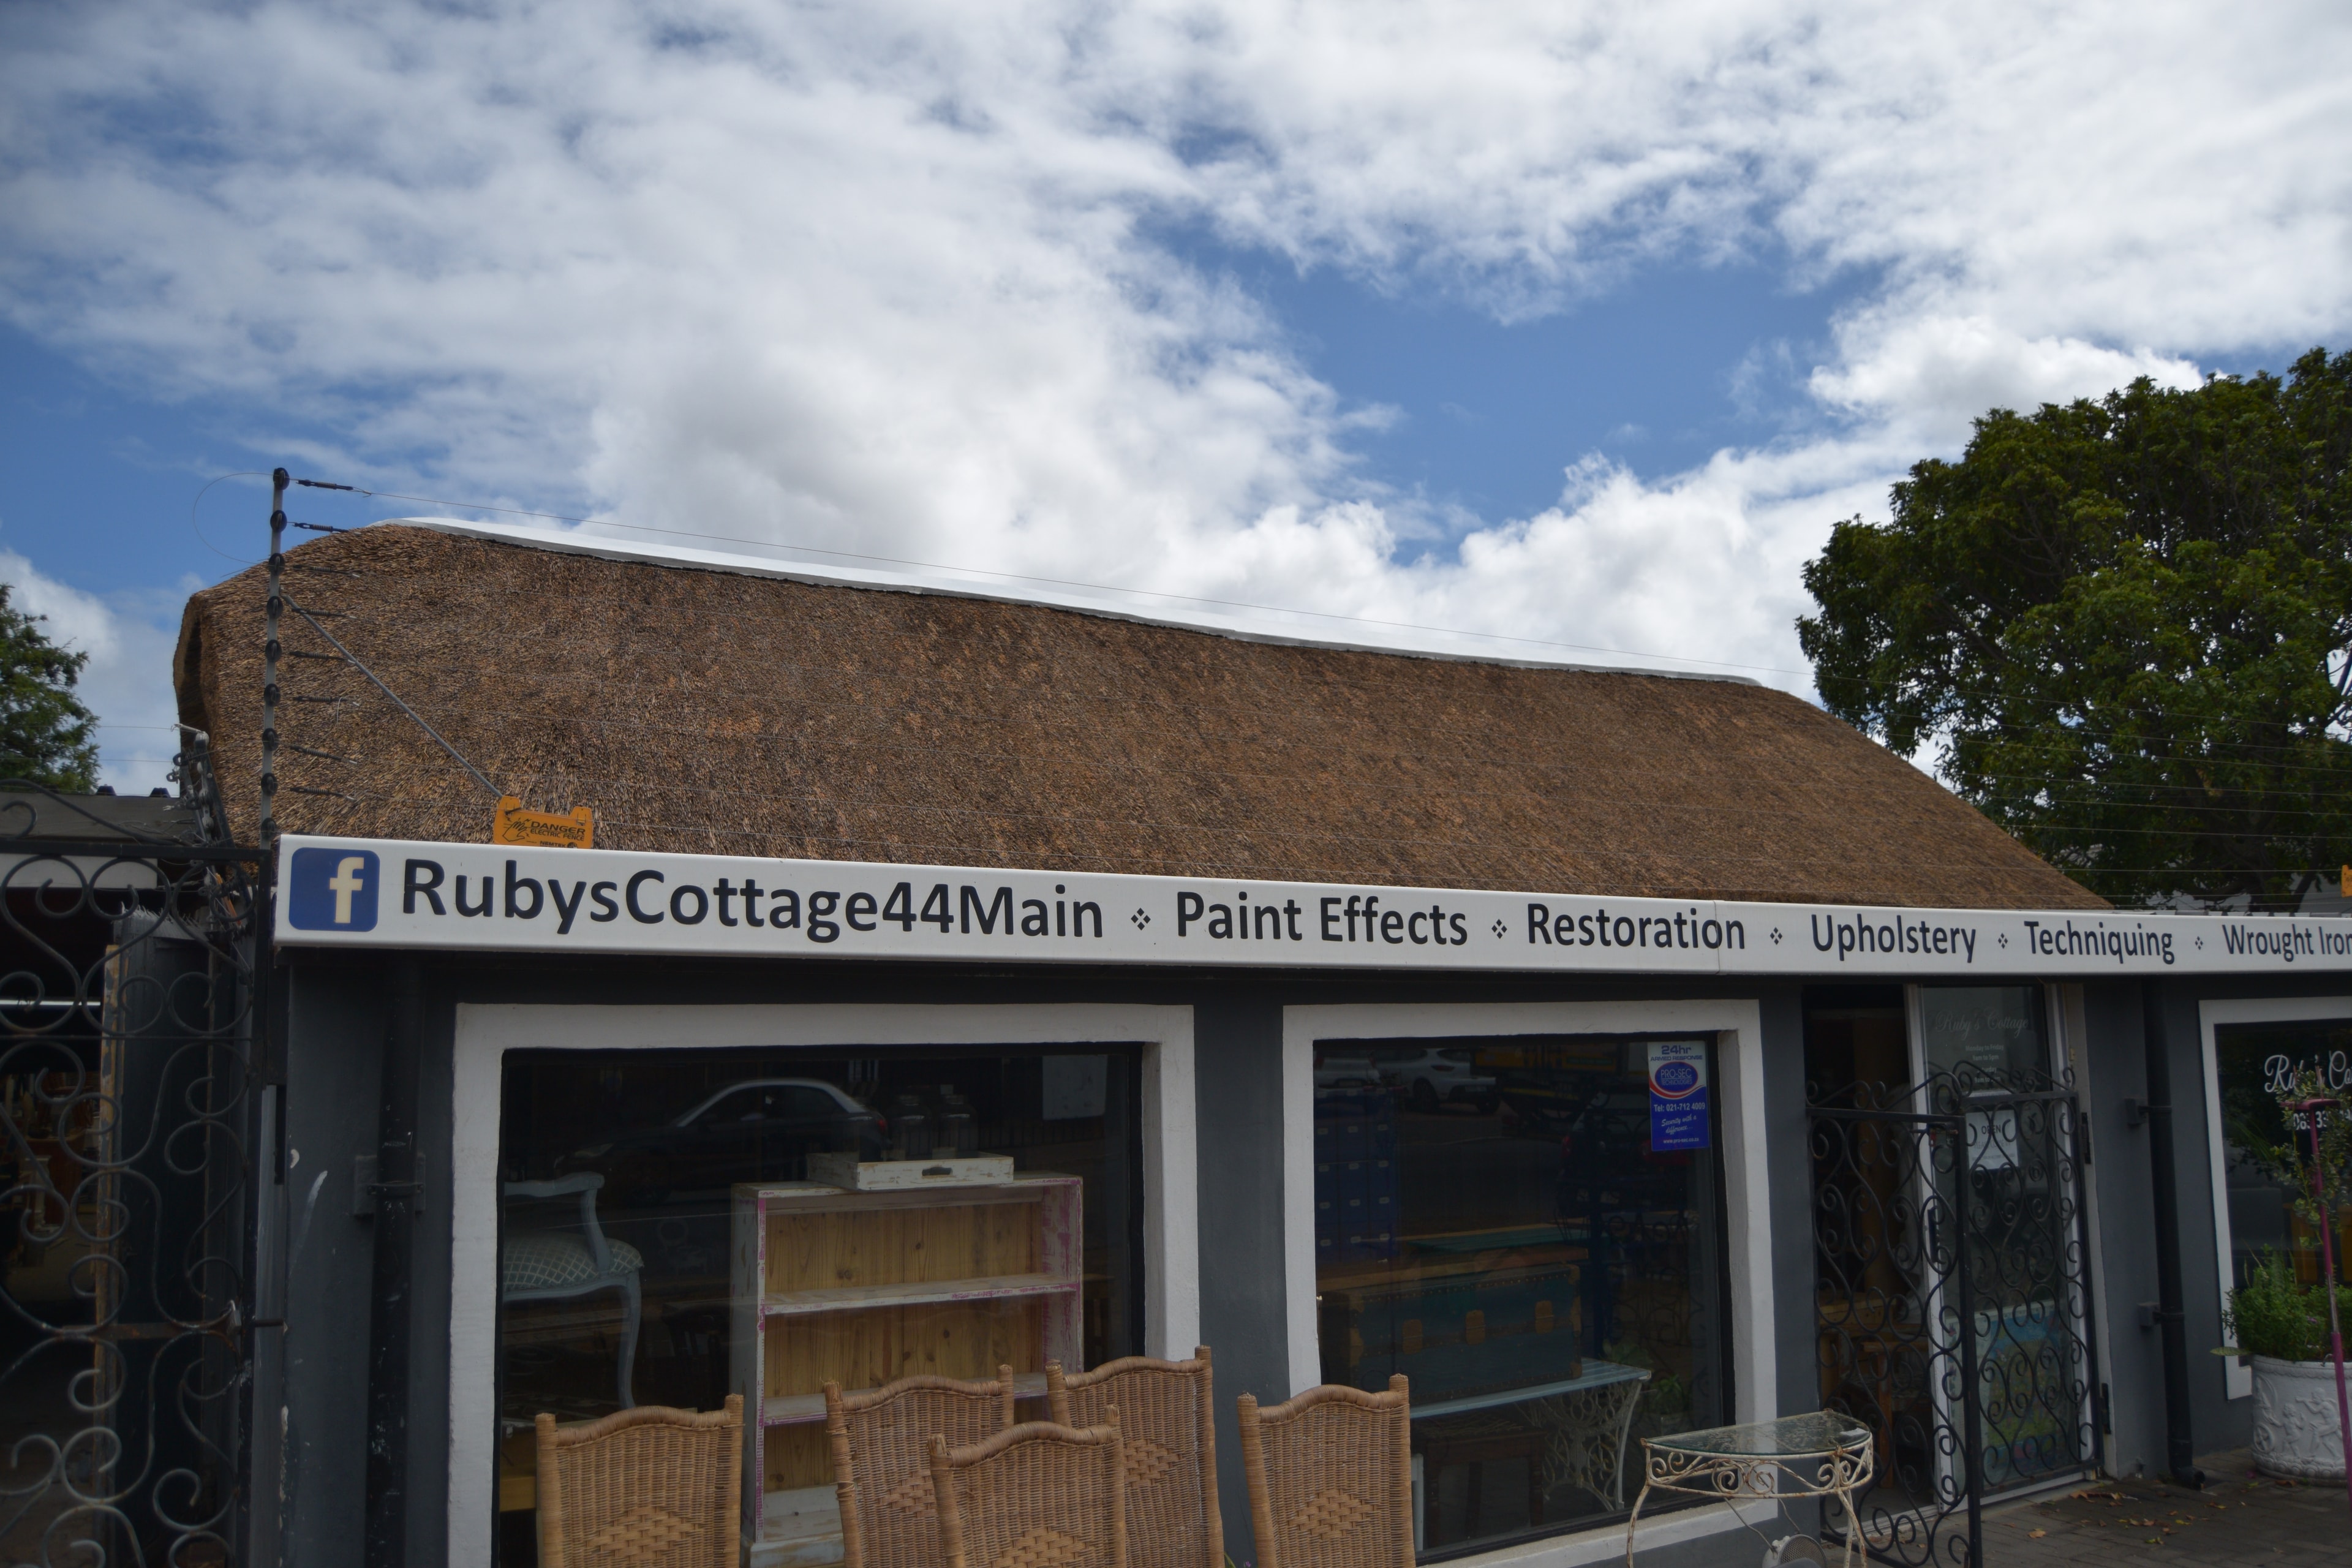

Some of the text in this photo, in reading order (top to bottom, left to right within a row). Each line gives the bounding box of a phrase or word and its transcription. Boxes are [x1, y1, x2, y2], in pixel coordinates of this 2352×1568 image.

[530, 821, 586, 835] DANGER
[530, 829, 561, 838] ELECTRIC
[402, 858, 1103, 943] RubysCottage44Main
[1177, 891, 1303, 941] Paint
[1320, 895, 1469, 946] Effects
[1528, 903, 1746, 949] Restoration
[1811, 913, 1977, 963] Upholstery
[2024, 920, 2175, 965] Techniquing
[2222, 924, 2314, 962] Wrought
[1936, 1008, 2029, 1040] Ruby's Cottage
[1661, 1045, 1692, 1055] 24hr
[1660, 1068, 1692, 1078] PRO-SEC
[1666, 1102, 1690, 1112] 021-712
[1661, 1118, 1681, 1126] Security
[1682, 1114, 1692, 1122] with
